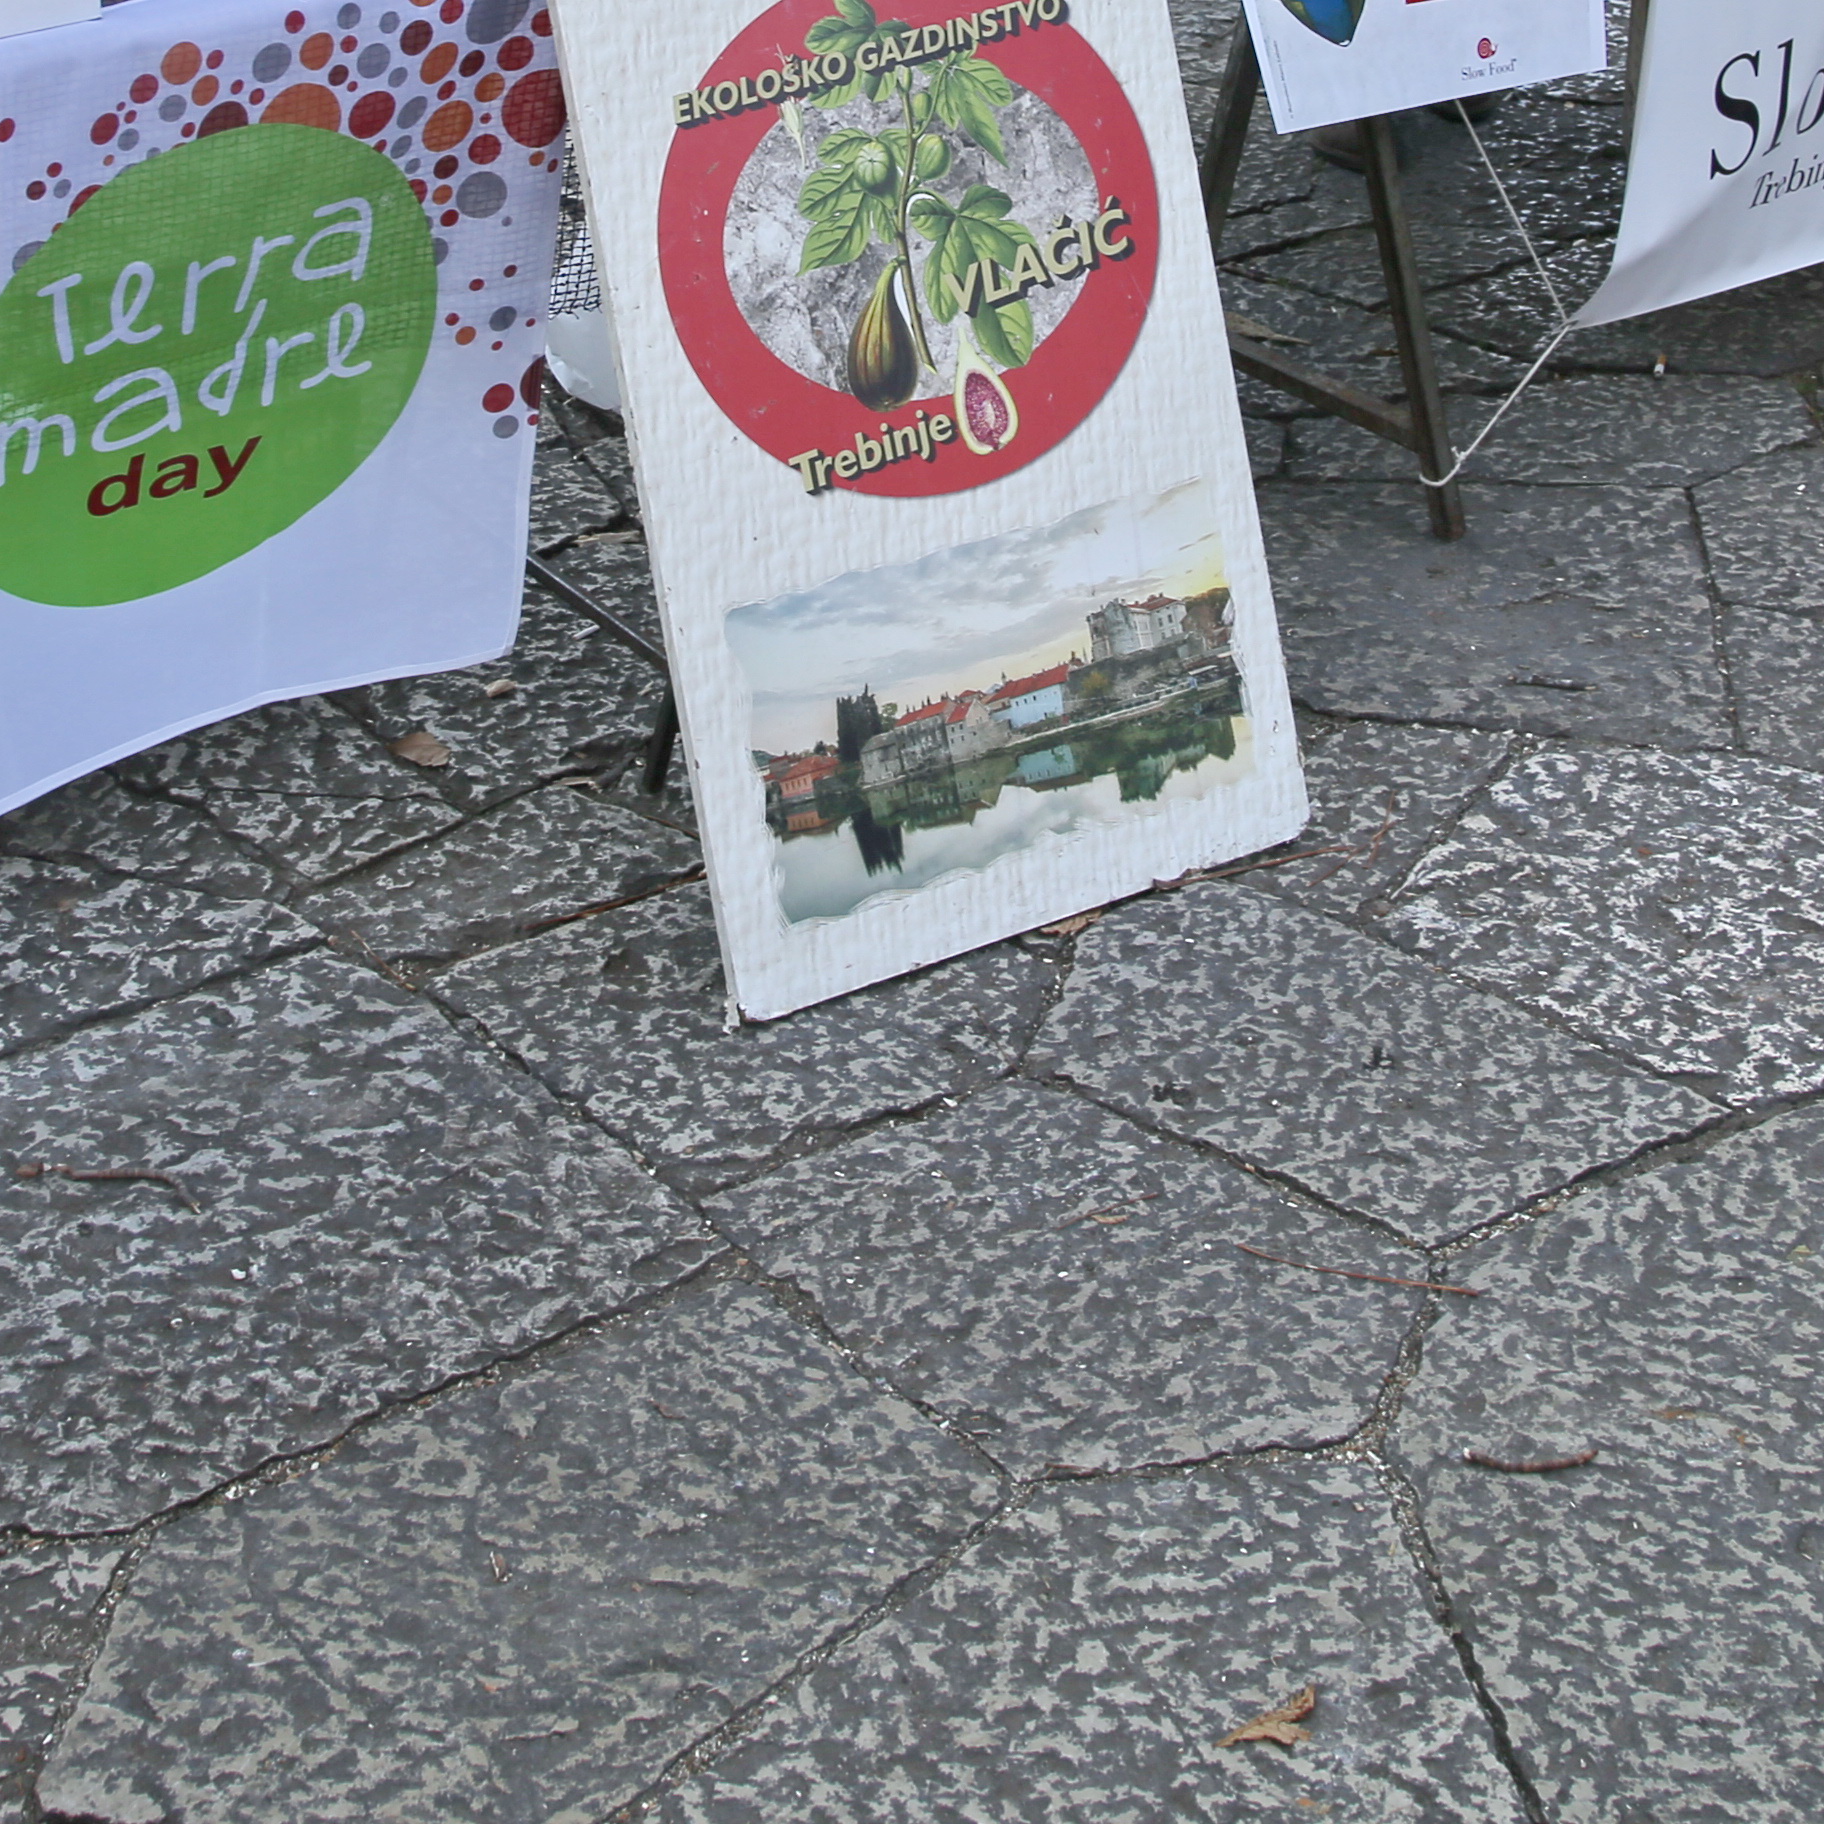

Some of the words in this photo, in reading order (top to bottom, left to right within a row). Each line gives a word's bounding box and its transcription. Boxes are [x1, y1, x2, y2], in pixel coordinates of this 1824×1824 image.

[672, 49, 848, 130] EKOLOŠKO
[1461, 64, 1486, 81] Slow
[1489, 60, 1515, 75] Food
[944, 196, 1135, 318] VLAČIĆ
[86, 436, 263, 518] day
[789, 409, 956, 497] Trebinje
